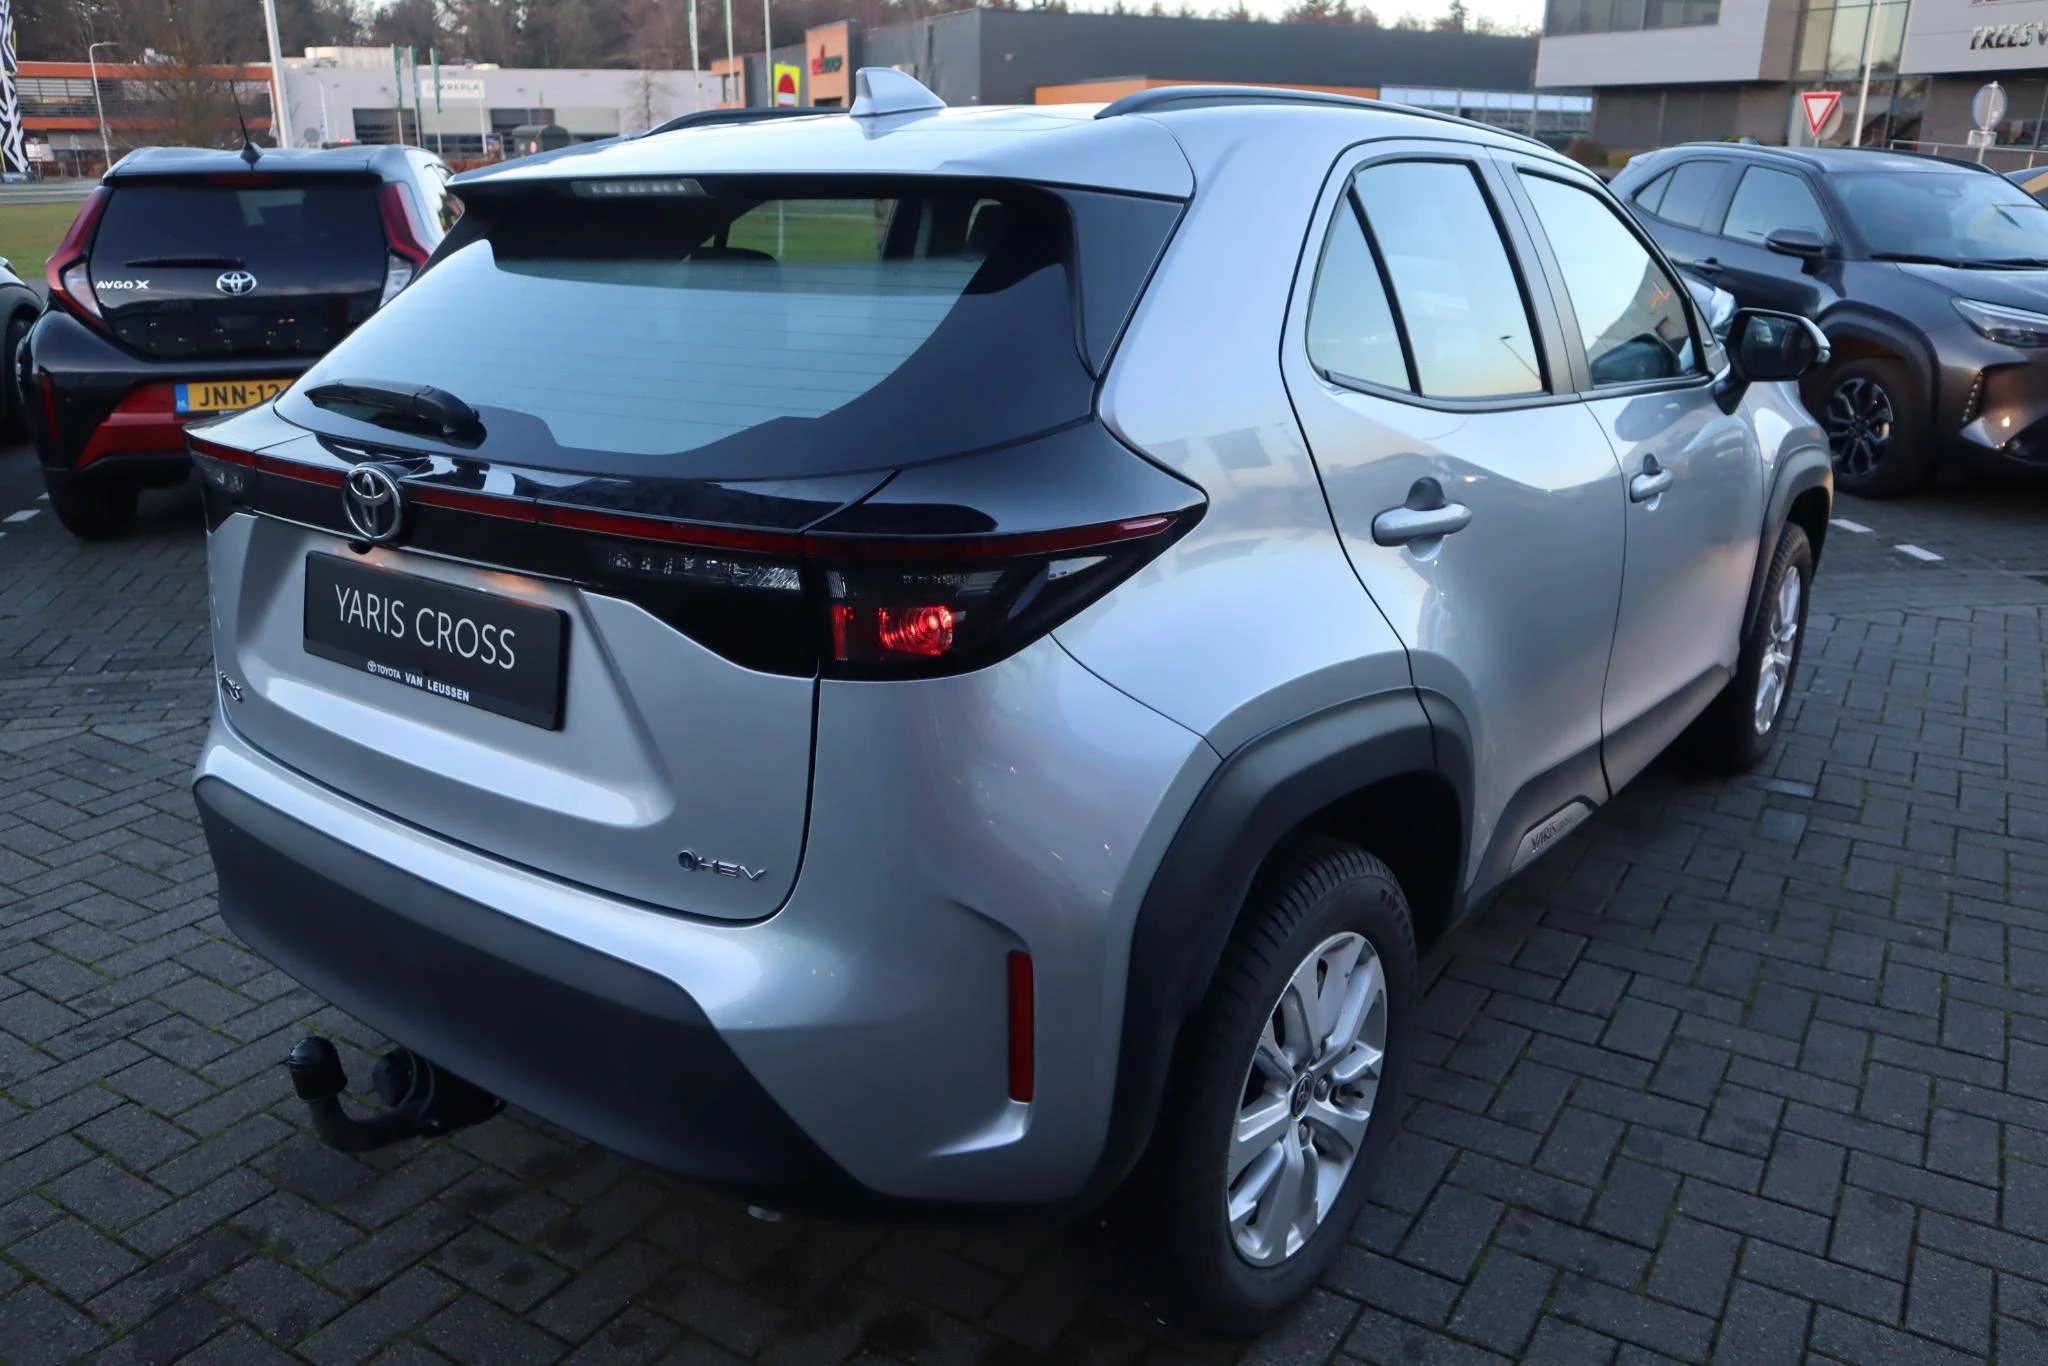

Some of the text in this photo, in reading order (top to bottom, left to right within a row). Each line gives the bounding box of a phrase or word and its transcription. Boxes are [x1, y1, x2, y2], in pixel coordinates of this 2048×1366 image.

[1970, 22, 2033, 50] FREES
[135, 280, 150, 290] X
[335, 584, 515, 669] YARIS CROSS
[377, 664, 470, 702] TOYOTA VAN LEUSSEN
[698, 856, 767, 881] HEV
